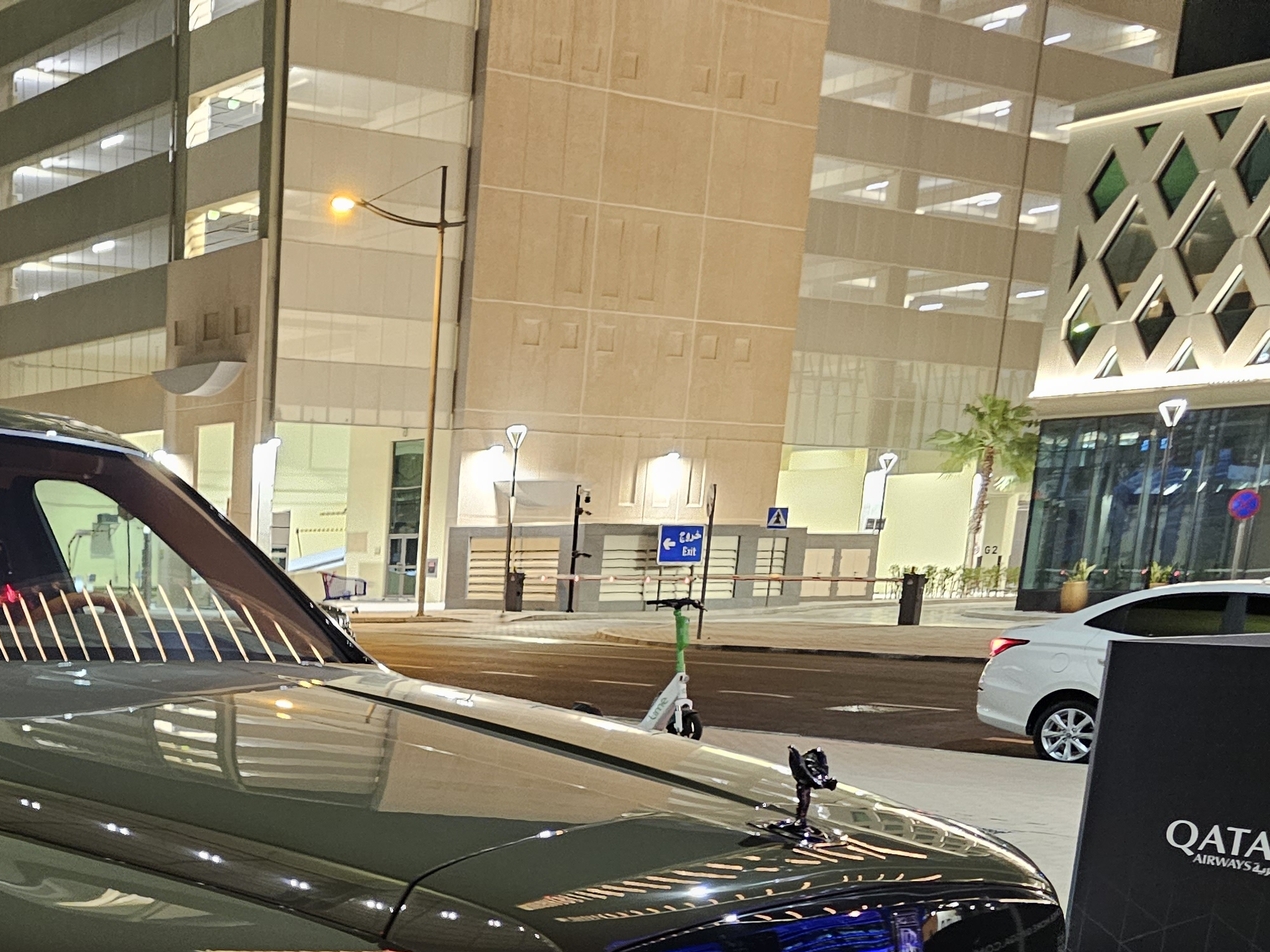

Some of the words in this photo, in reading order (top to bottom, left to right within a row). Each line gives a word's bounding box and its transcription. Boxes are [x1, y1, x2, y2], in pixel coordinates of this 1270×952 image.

[679, 530, 702, 544] خروج
[682, 545, 697, 557] Exit
[1192, 853, 1252, 871] AIRWAYS
